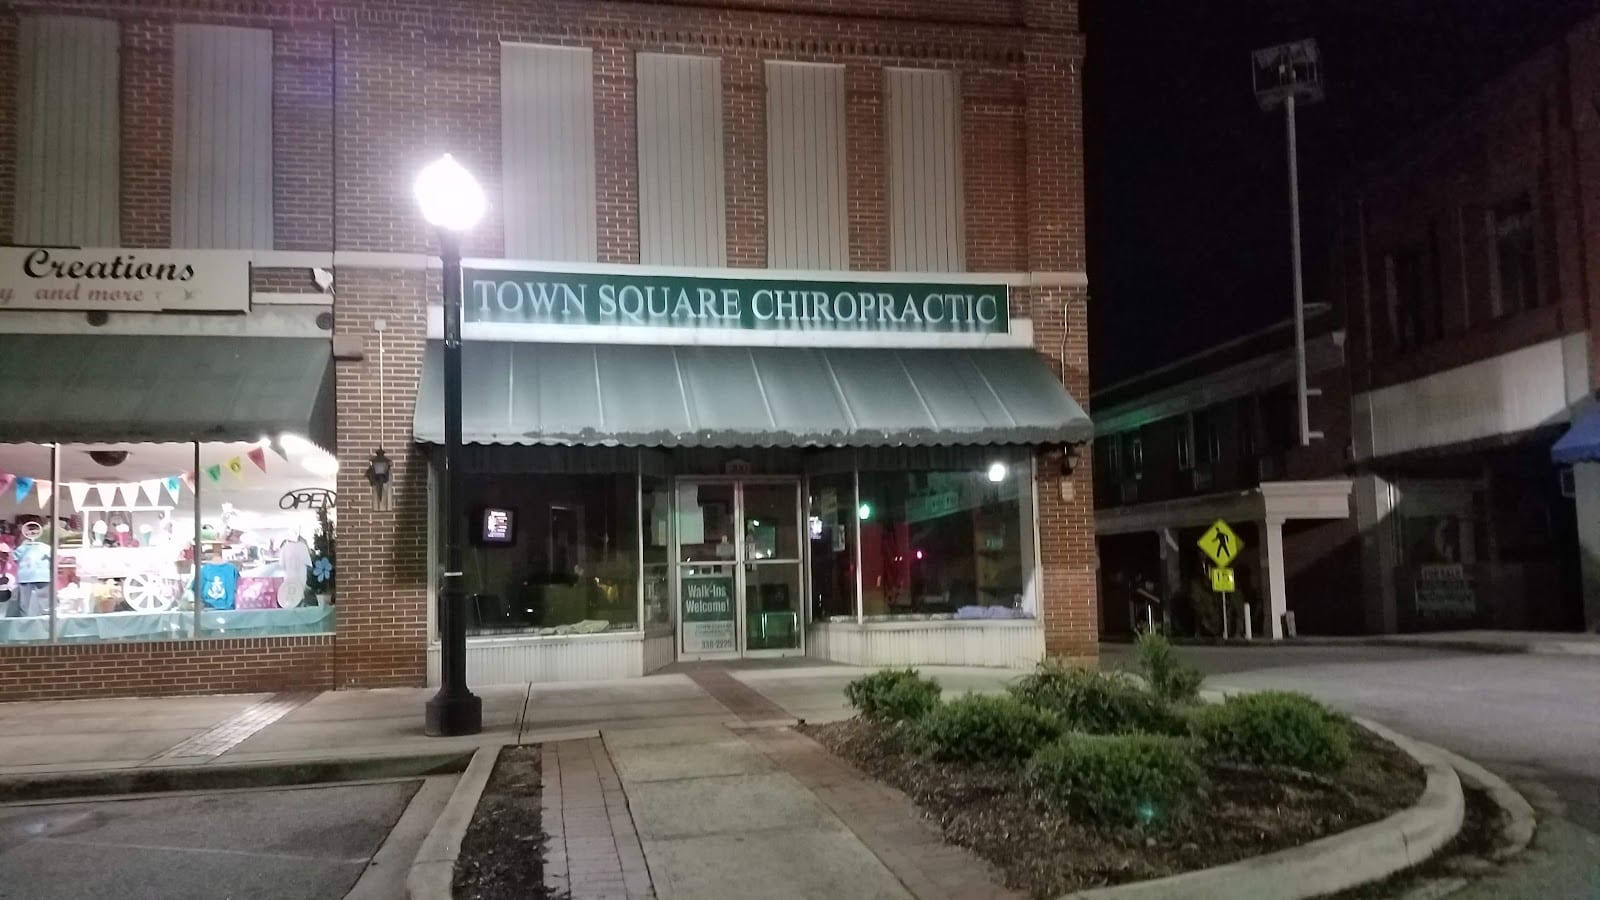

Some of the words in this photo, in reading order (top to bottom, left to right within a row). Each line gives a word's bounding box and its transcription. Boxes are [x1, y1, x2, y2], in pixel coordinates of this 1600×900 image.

[24, 249, 195, 282] Creations
[35, 283, 81, 301] and
[87, 288, 145, 302] more
[473, 280, 588, 315] TOWN
[598, 285, 742, 324] SQUARE
[751, 289, 997, 324] CHIROPRACTIC
[279, 489, 337, 510] OPEN
[686, 599, 730, 613] Welcome!
